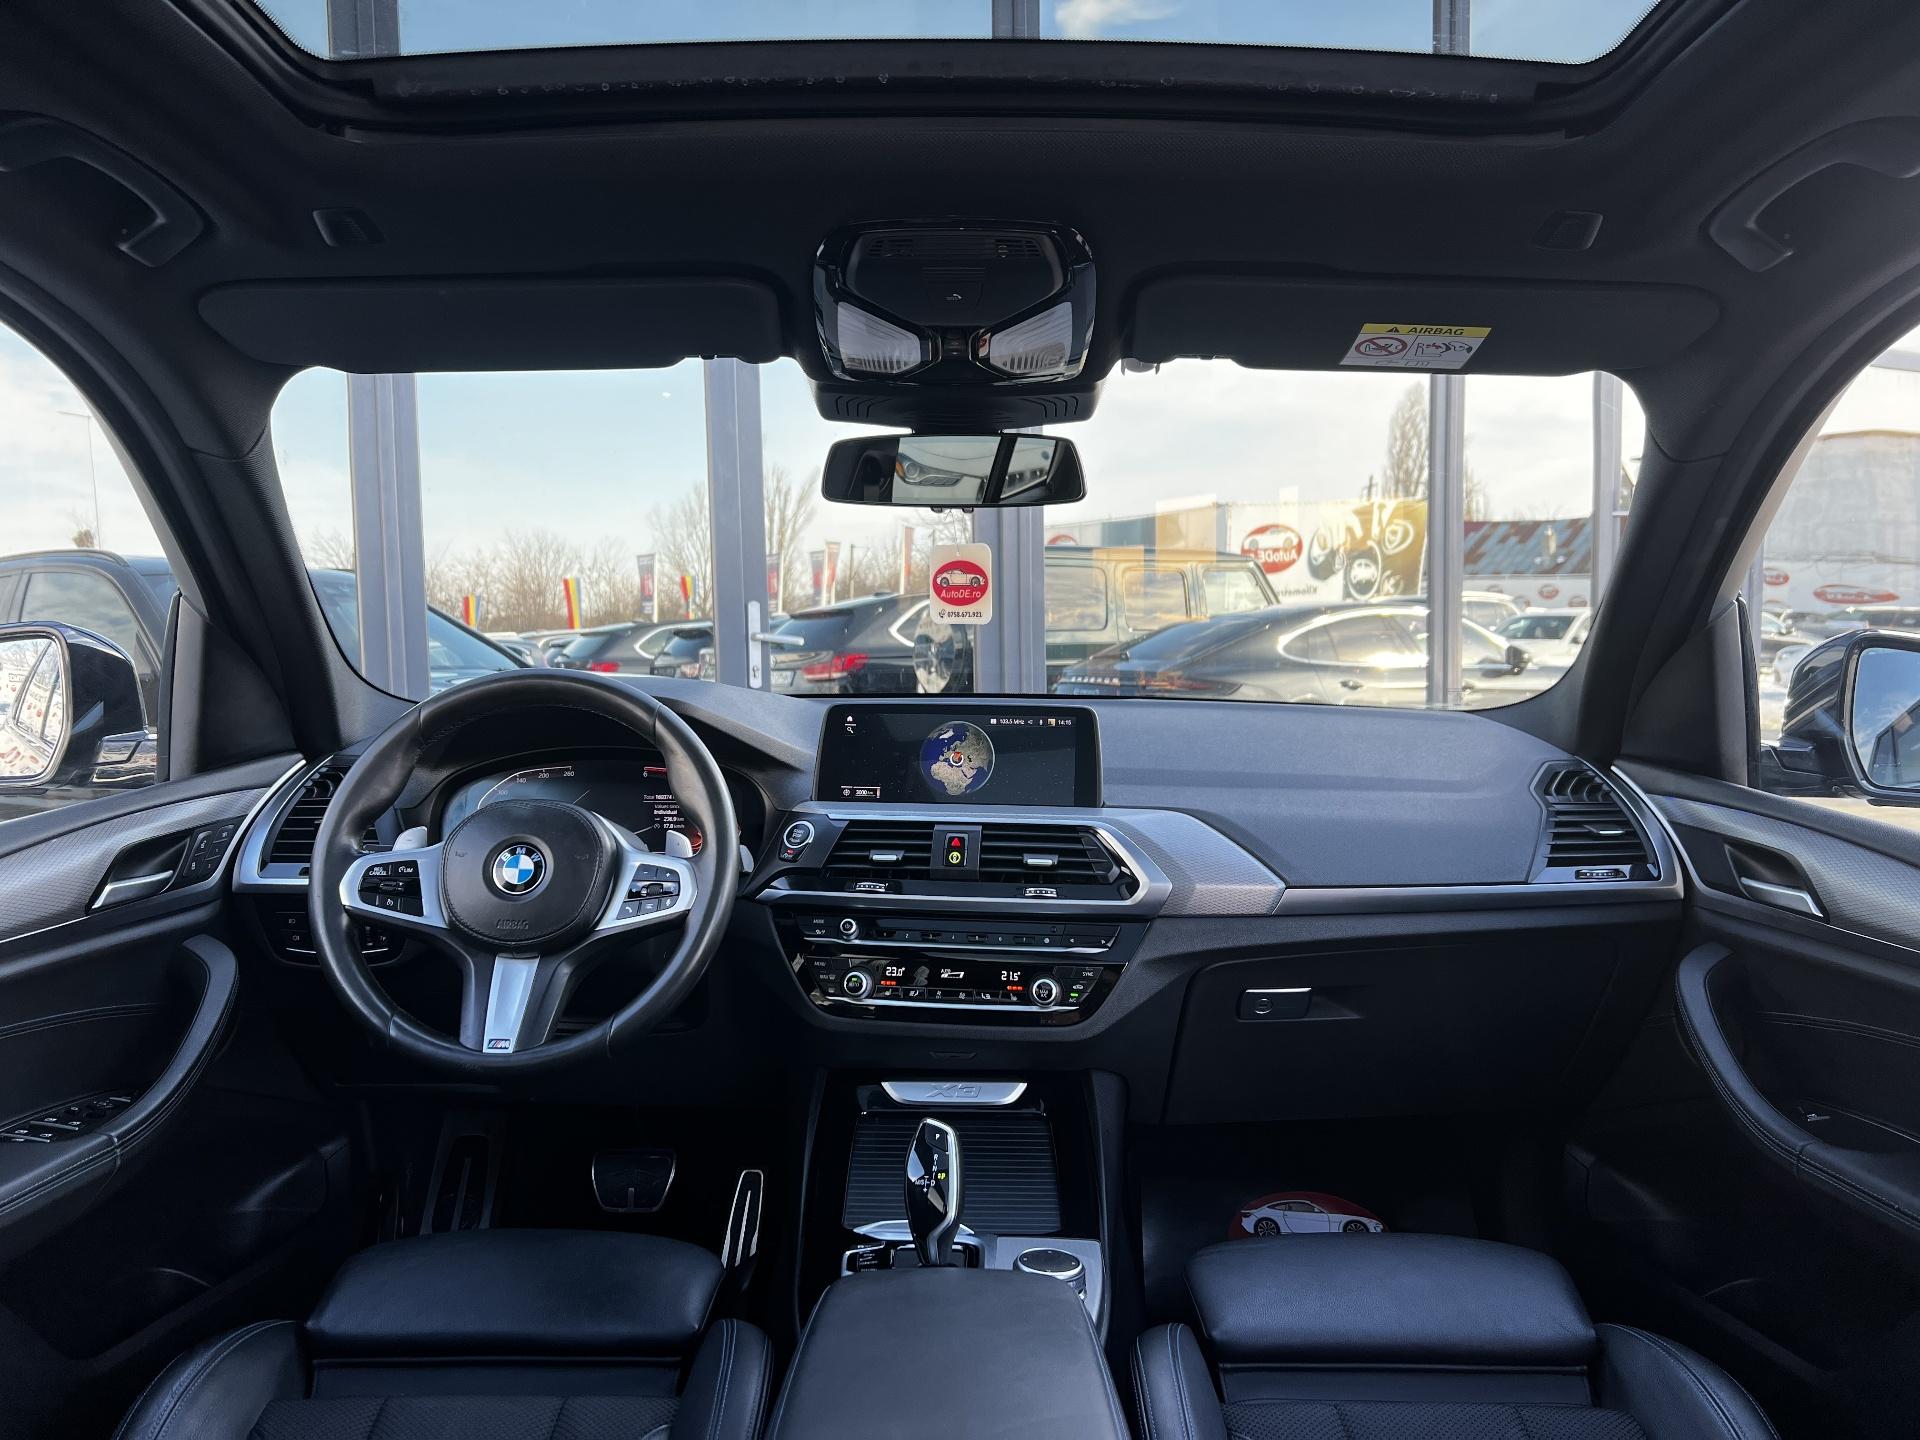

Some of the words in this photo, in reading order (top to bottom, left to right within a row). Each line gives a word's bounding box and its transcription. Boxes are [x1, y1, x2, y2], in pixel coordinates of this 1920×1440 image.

[1408, 327, 1464, 336] AIRBAG
[940, 589, 981, 598] AutoDE.ro
[500, 847, 541, 862] BMW
[926, 1083, 982, 1098] X3
